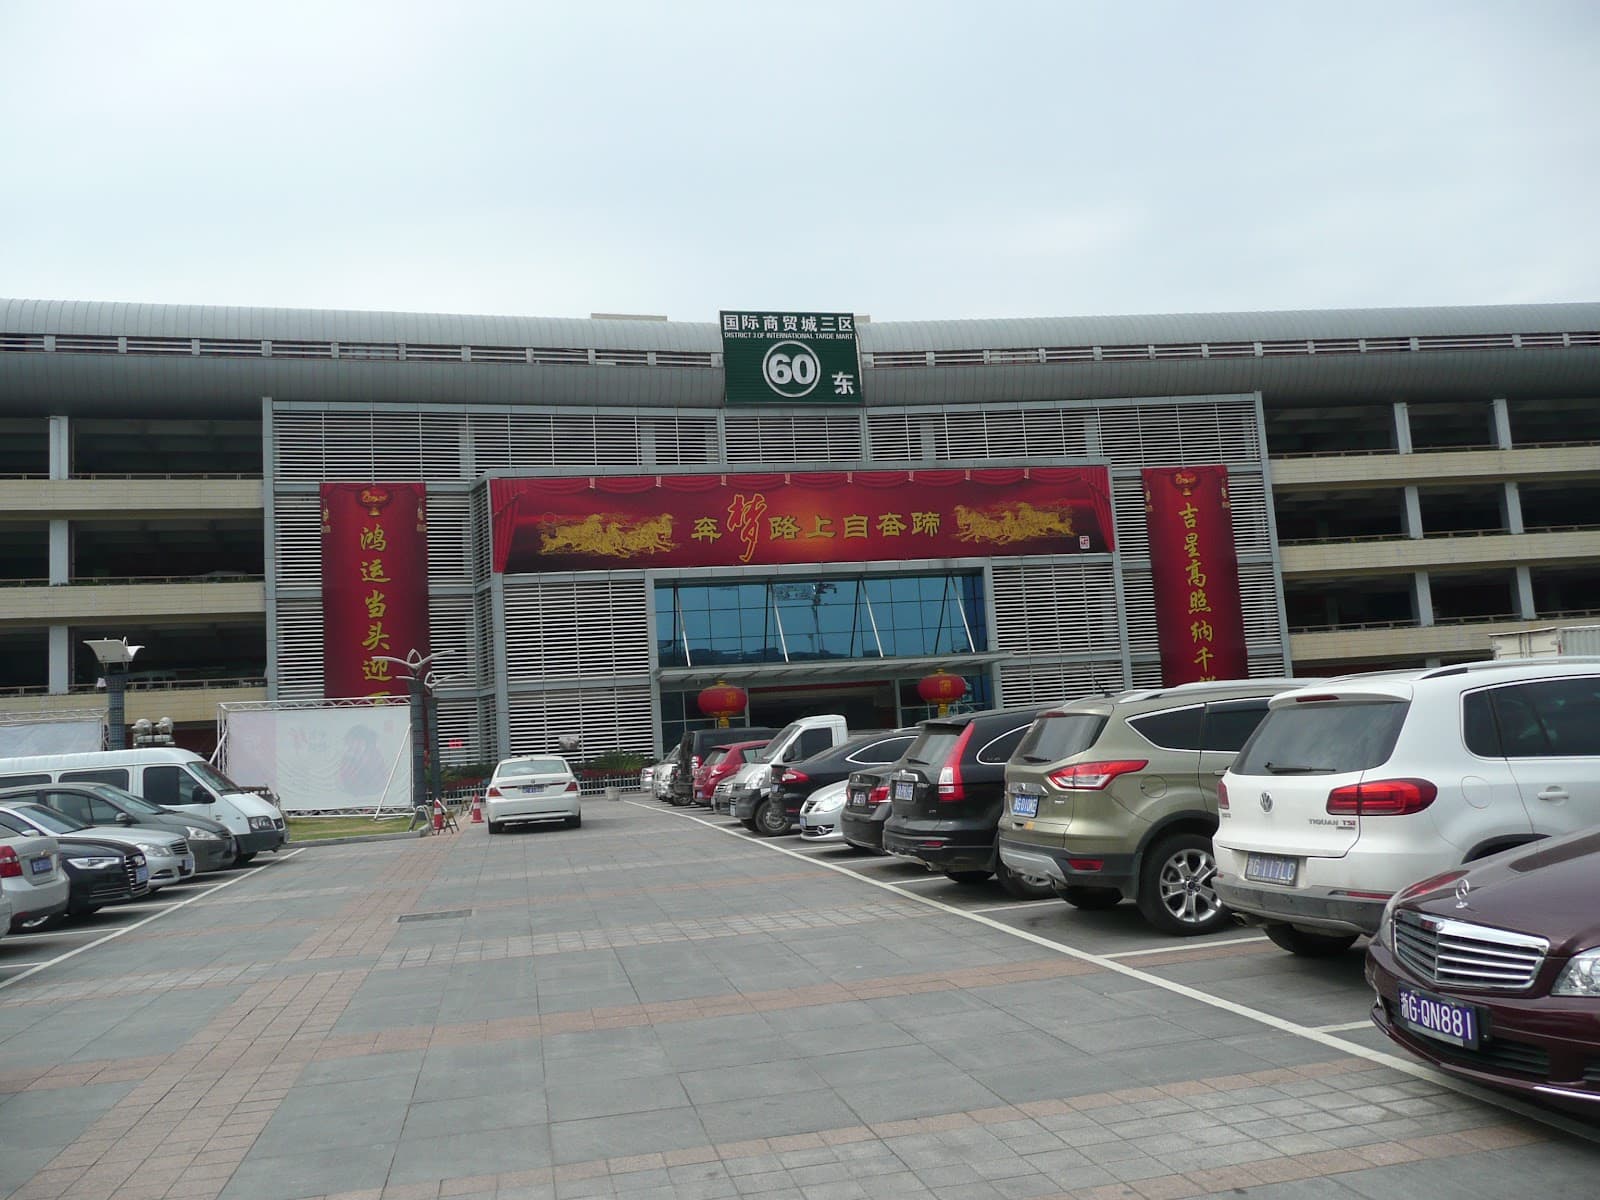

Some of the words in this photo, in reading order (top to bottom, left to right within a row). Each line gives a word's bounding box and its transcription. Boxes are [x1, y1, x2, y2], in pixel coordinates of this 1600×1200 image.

[723, 315, 853, 331] 国际商贸城三区
[724, 331, 752, 339] DISTRICT
[768, 353, 815, 384] 60
[832, 371, 854, 394] 东
[1178, 502, 1217, 682] 吉星高照纳千
